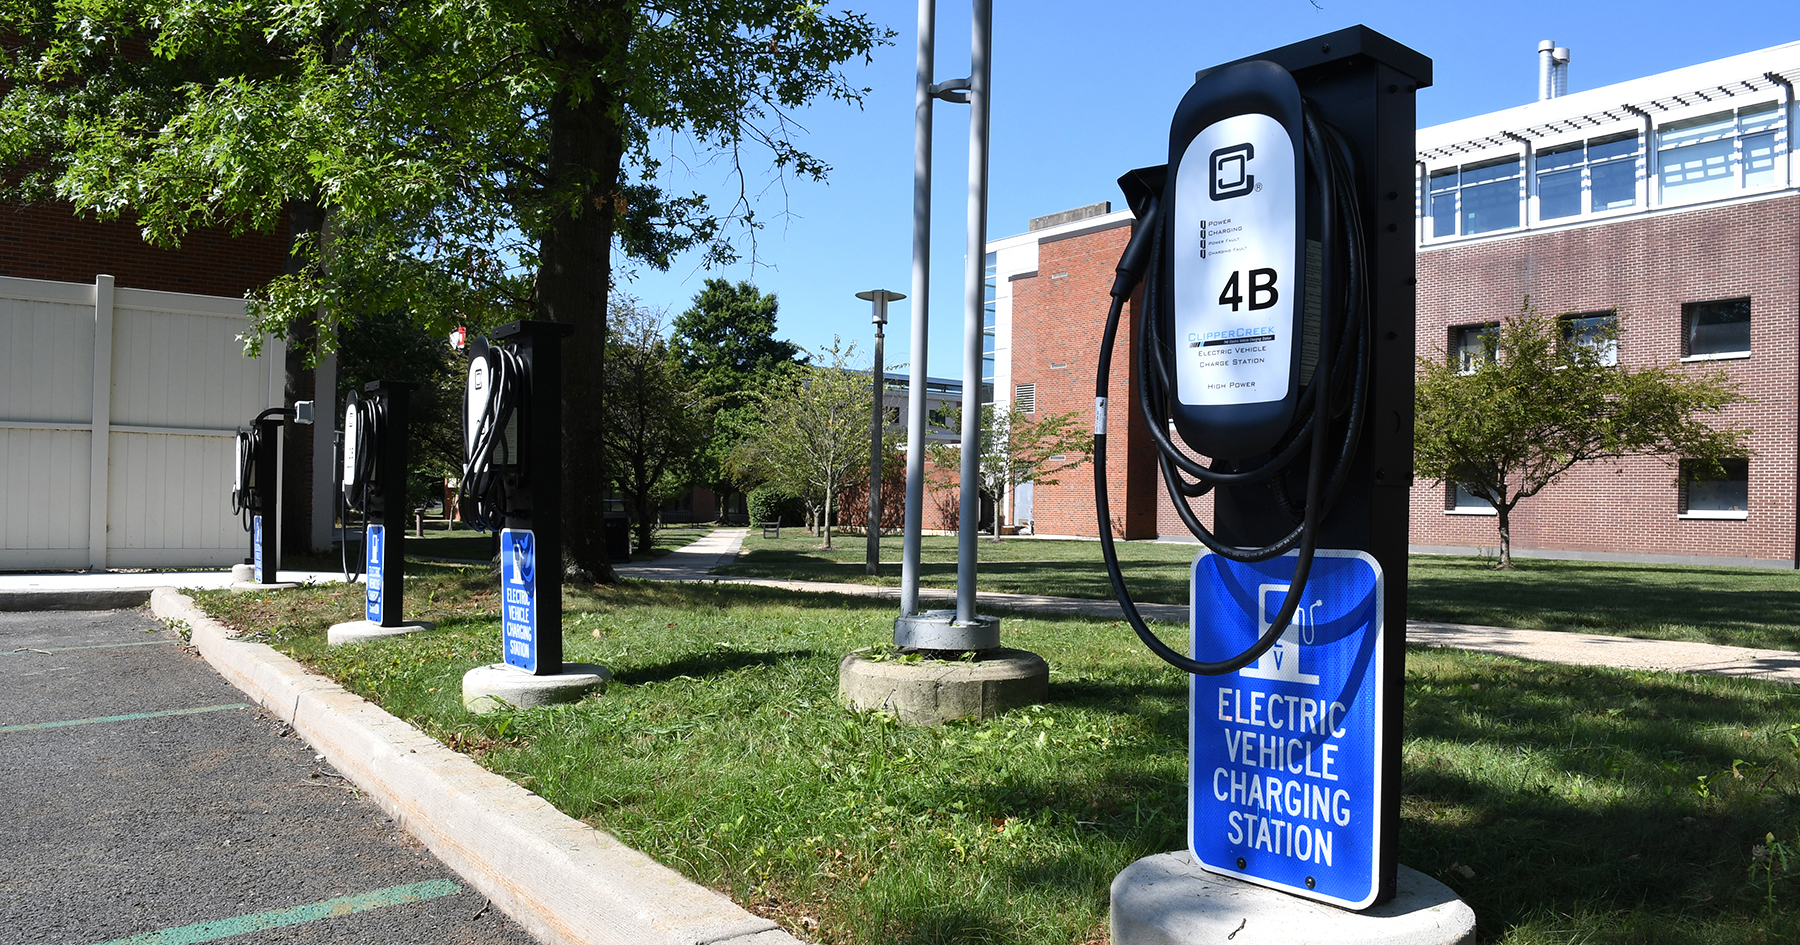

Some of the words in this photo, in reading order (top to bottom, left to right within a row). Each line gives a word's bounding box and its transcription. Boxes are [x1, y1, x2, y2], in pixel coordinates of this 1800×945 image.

[1218, 267, 1279, 312] 4B
[1232, 358, 1265, 366] STATION
[1234, 345, 1267, 353] VEHICLE
[508, 604, 530, 623] VEHICLE
[506, 621, 532, 641] CHARGING
[509, 639, 529, 659] STATION
[1218, 687, 1346, 739] ELECTRIC
[1225, 728, 1338, 781] VEHICLE
[1213, 767, 1350, 827] CHARGING
[1227, 810, 1333, 867] STATION
